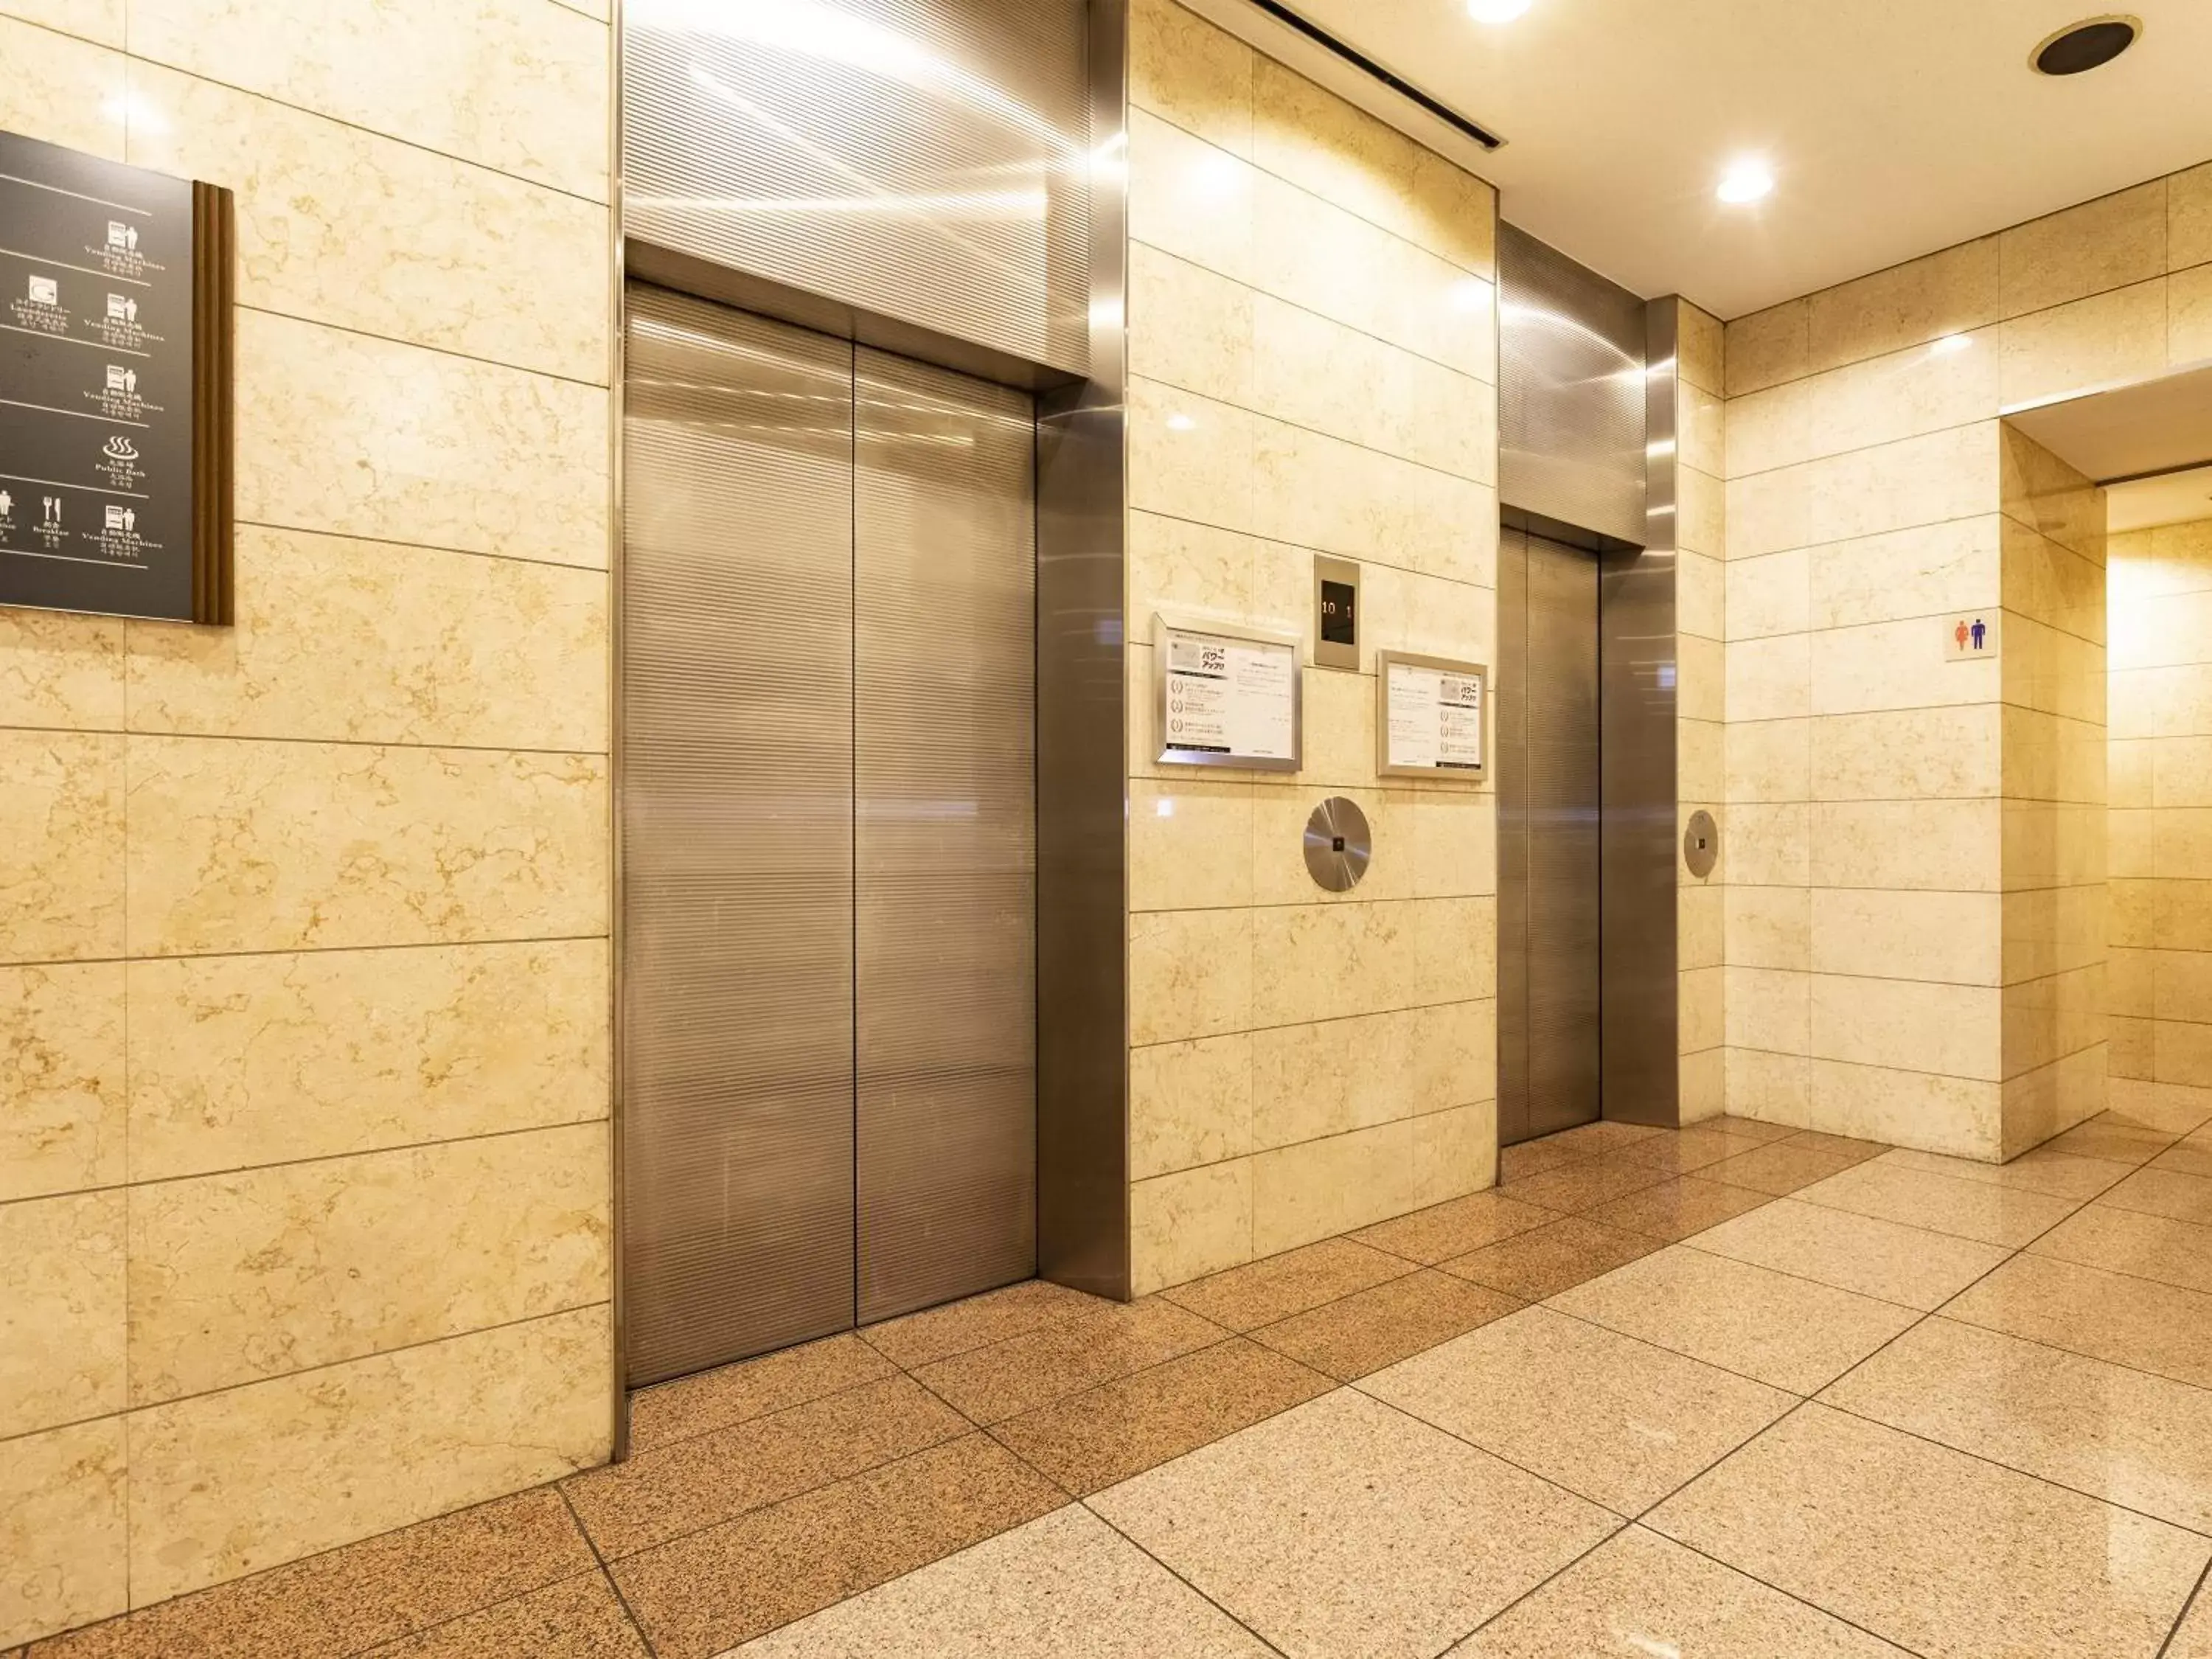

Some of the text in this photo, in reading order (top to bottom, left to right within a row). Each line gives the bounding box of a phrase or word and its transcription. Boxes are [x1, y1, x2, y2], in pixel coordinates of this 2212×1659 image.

[83, 319, 121, 333] Vending
[83, 390, 120, 405] Vending
[123, 398, 164, 411] Machines
[95, 463, 123, 473] Public
[126, 468, 145, 478] Bath
[82, 532, 163, 549] Vending Machines
[1322, 601, 1352, 619] 10 1
